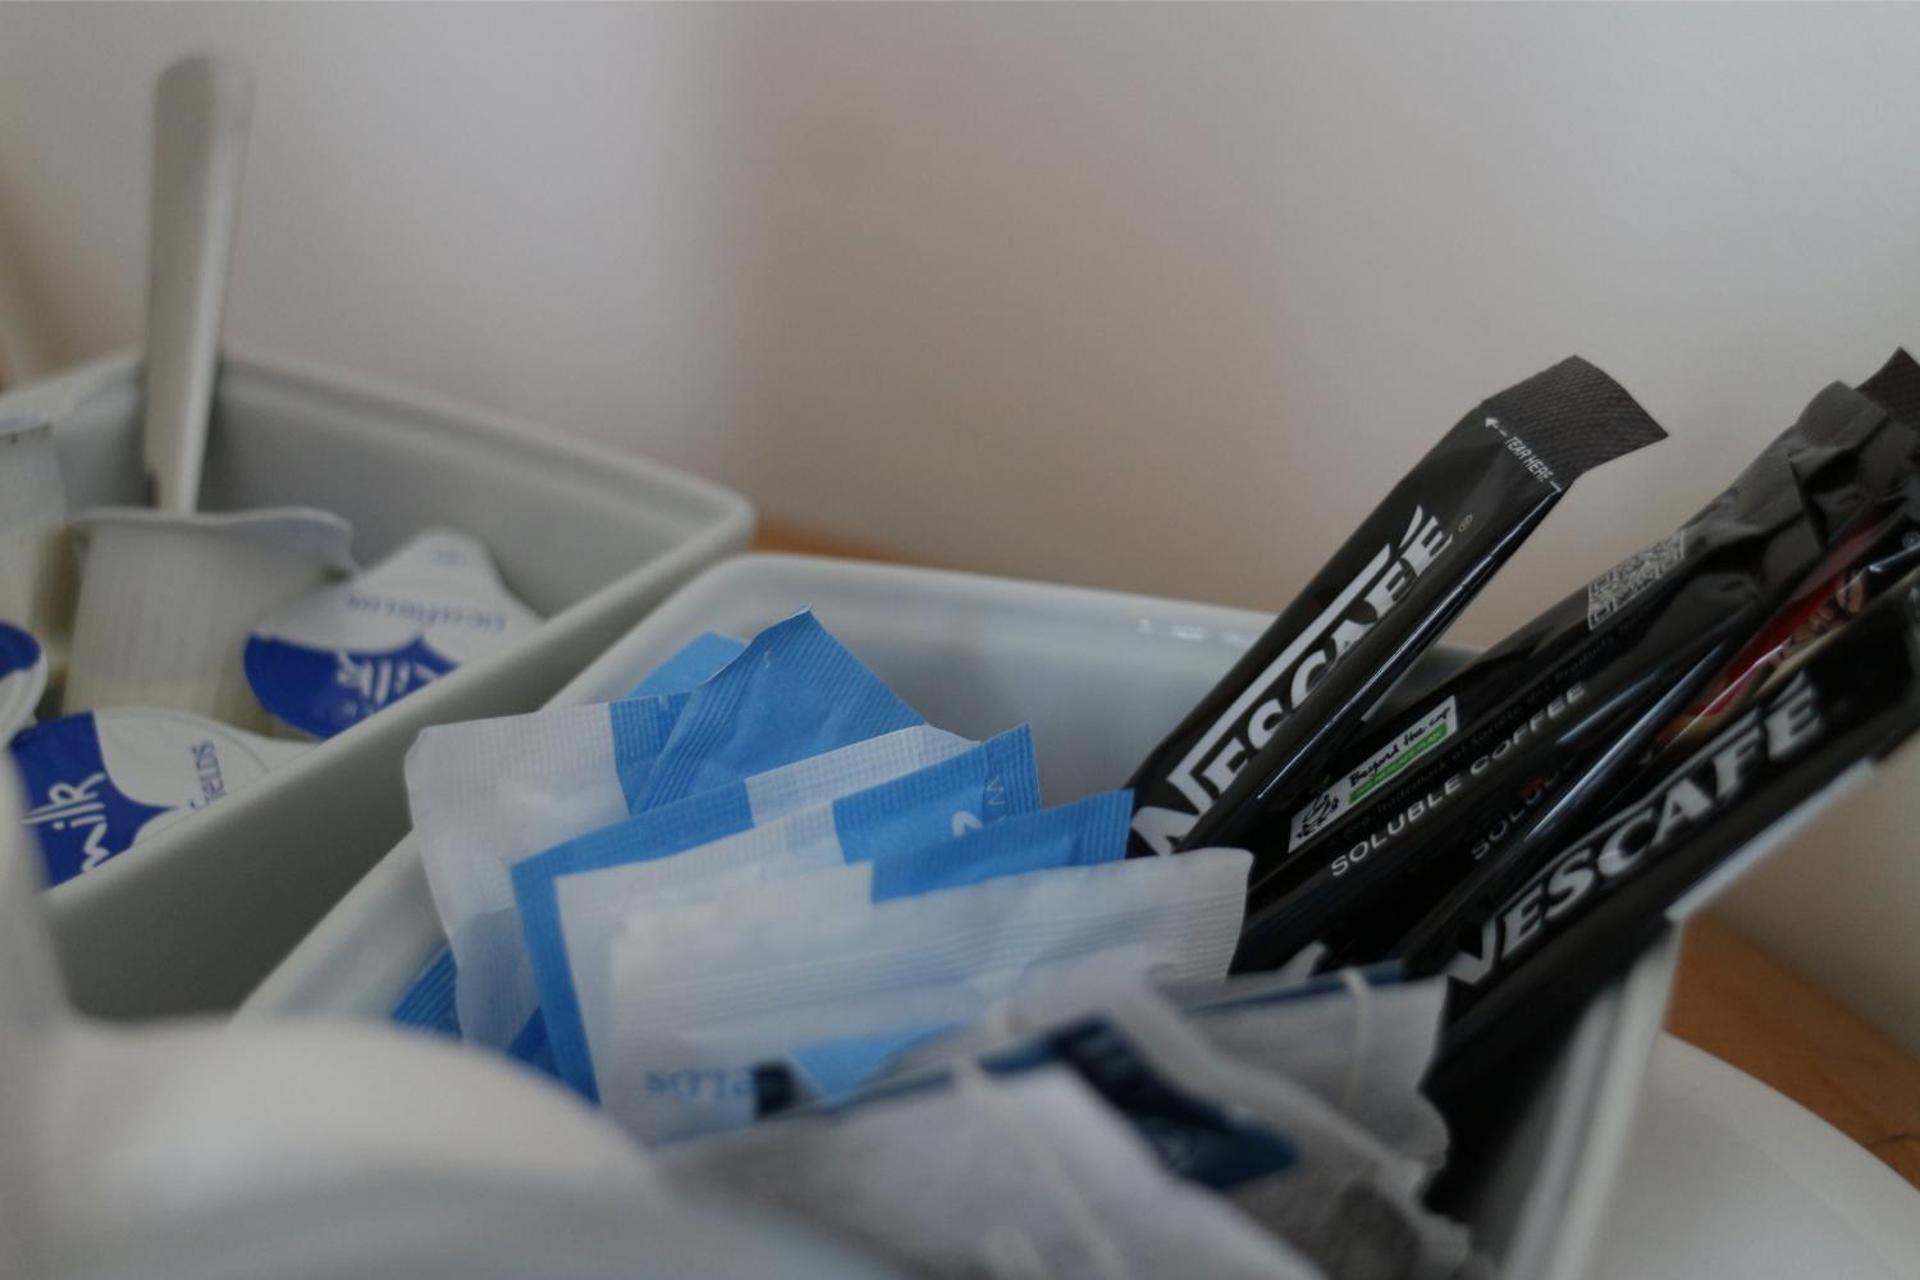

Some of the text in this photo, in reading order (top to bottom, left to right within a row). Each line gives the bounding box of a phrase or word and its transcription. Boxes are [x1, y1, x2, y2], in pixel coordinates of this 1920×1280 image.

[1503, 435, 1554, 483] TEAR HERE
[21, 772, 107, 874] milk
[1331, 776, 1463, 878] SOLUBLE
[1470, 681, 1585, 775] COFFEE
